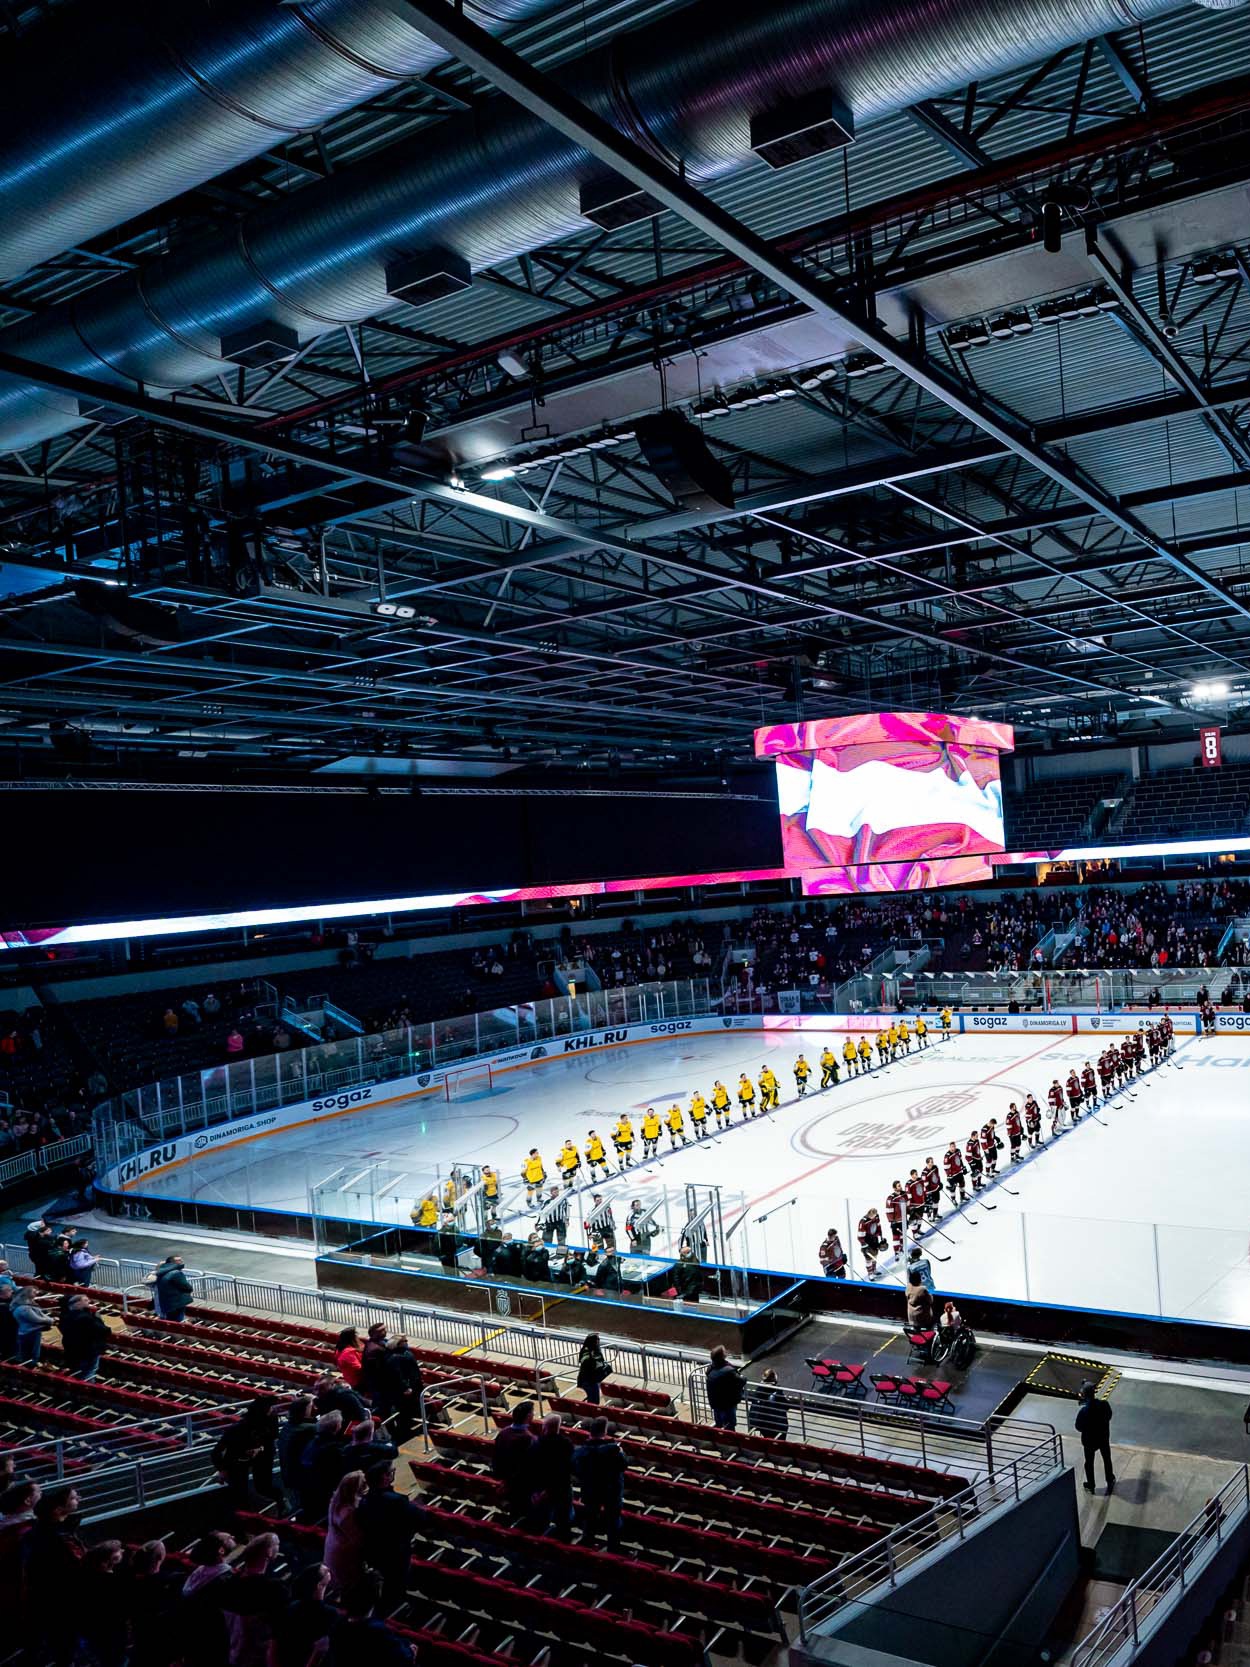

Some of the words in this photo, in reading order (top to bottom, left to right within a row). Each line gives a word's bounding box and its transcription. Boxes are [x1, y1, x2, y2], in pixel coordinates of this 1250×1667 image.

[1206, 736, 1218, 759] 8
[650, 1021, 692, 1033] sogaz
[974, 1017, 1007, 1029] sogaz
[564, 1030, 628, 1051] KHL.RU
[312, 1089, 372, 1111] sogaz
[836, 1123, 945, 1139] DINAMO
[837, 1135, 902, 1149] RIGA
[118, 1144, 177, 1184] KHL.RU
